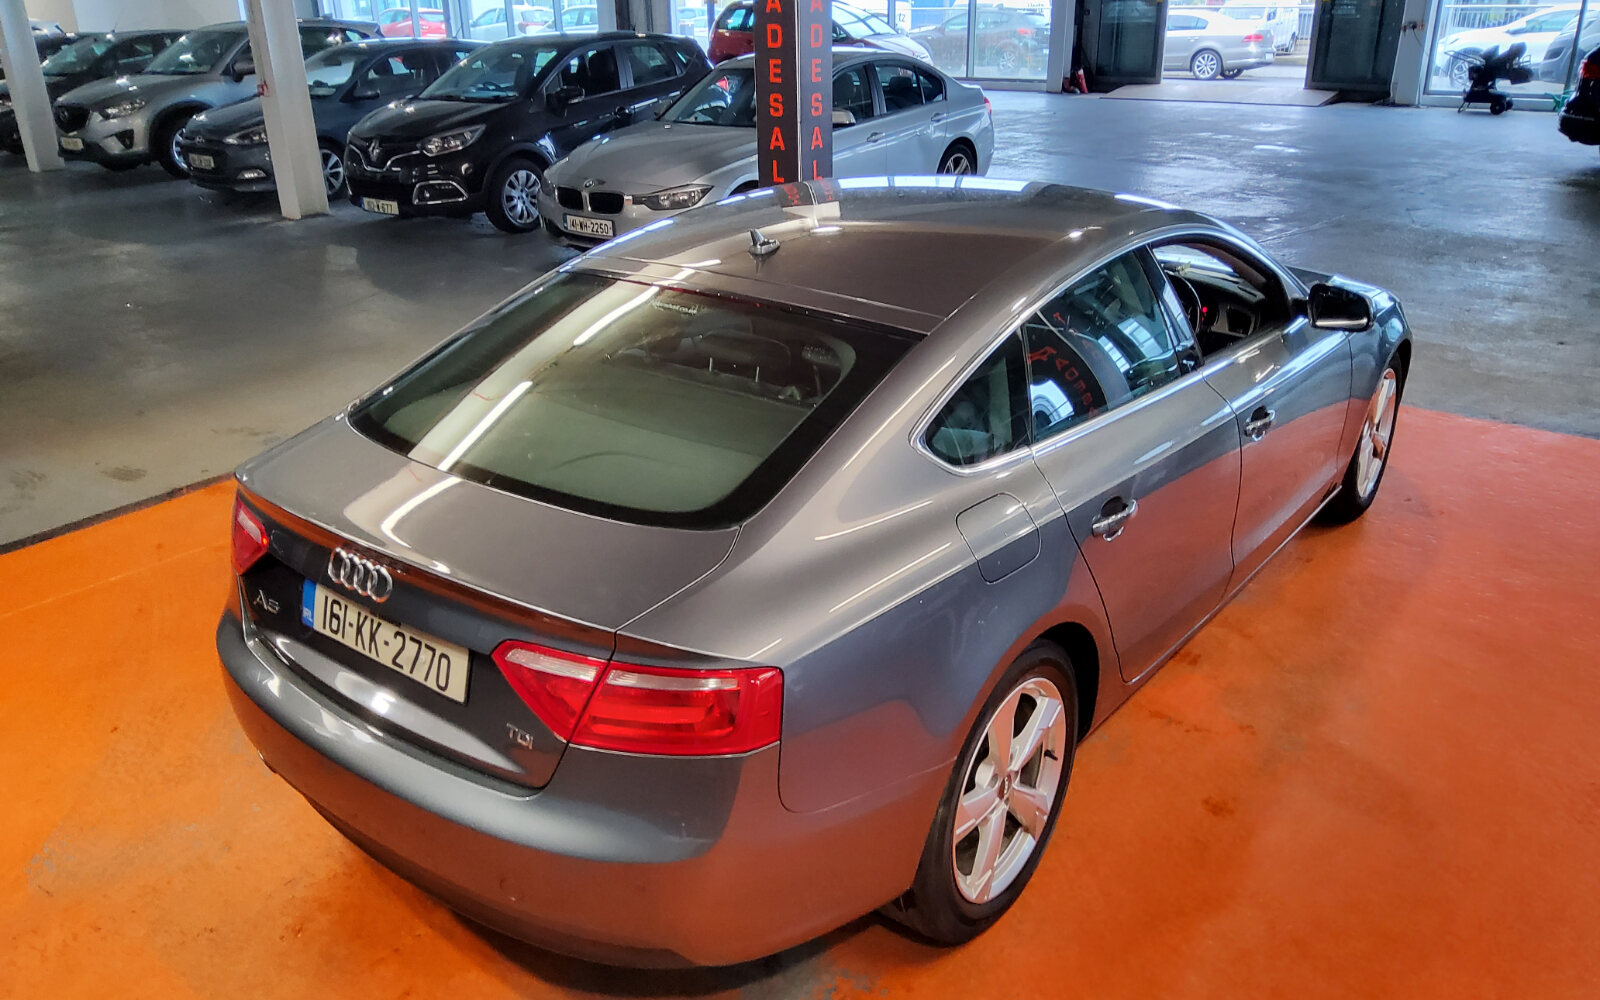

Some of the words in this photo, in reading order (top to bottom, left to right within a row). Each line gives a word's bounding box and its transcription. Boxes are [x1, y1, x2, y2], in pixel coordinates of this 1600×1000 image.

[253, 589, 280, 615] A5
[322, 595, 451, 692] 161-KK-2770
[506, 722, 534, 750] TDI
